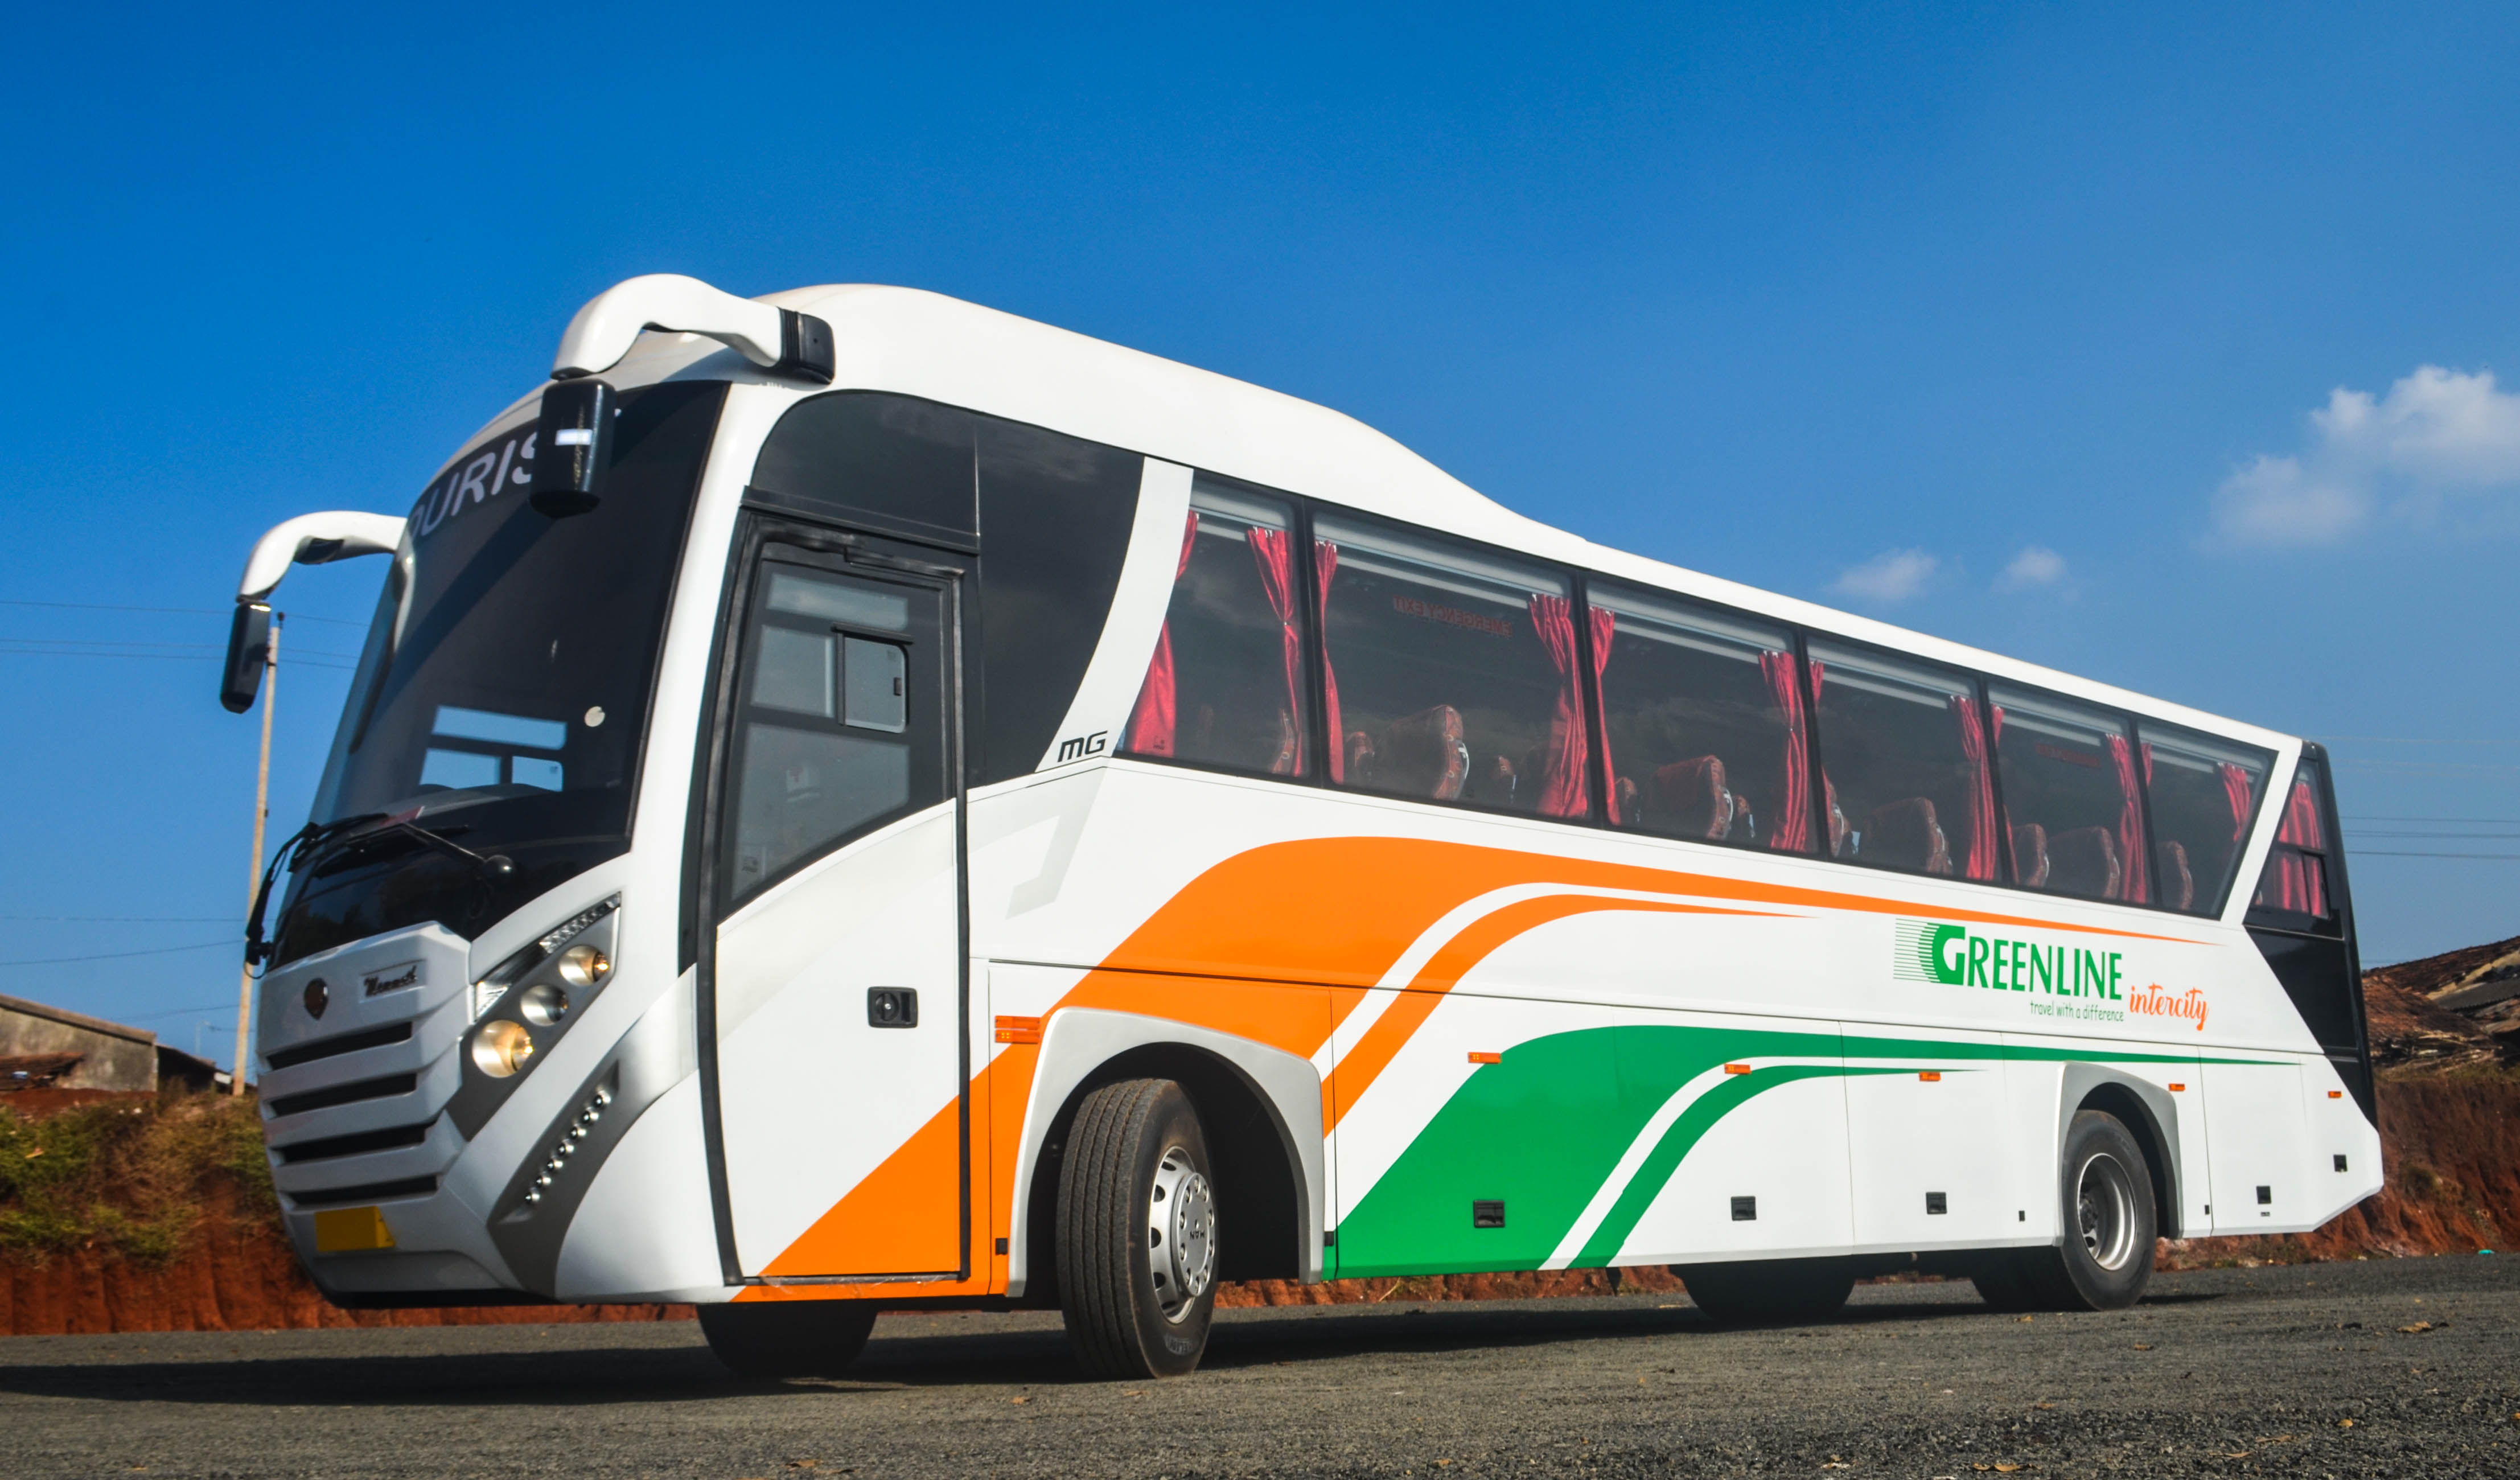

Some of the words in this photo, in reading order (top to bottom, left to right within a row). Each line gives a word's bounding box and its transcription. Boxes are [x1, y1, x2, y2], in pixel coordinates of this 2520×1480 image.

[1057, 730, 1108, 763] MG
[1927, 923, 2122, 1000] GREENLINE
[2030, 1000, 2054, 1016] travel
[2056, 1002, 2074, 1018] with
[2076, 1008, 2081, 1019] a
[2083, 1004, 2124, 1022] difference
[2130, 982, 2209, 1031] intercity
